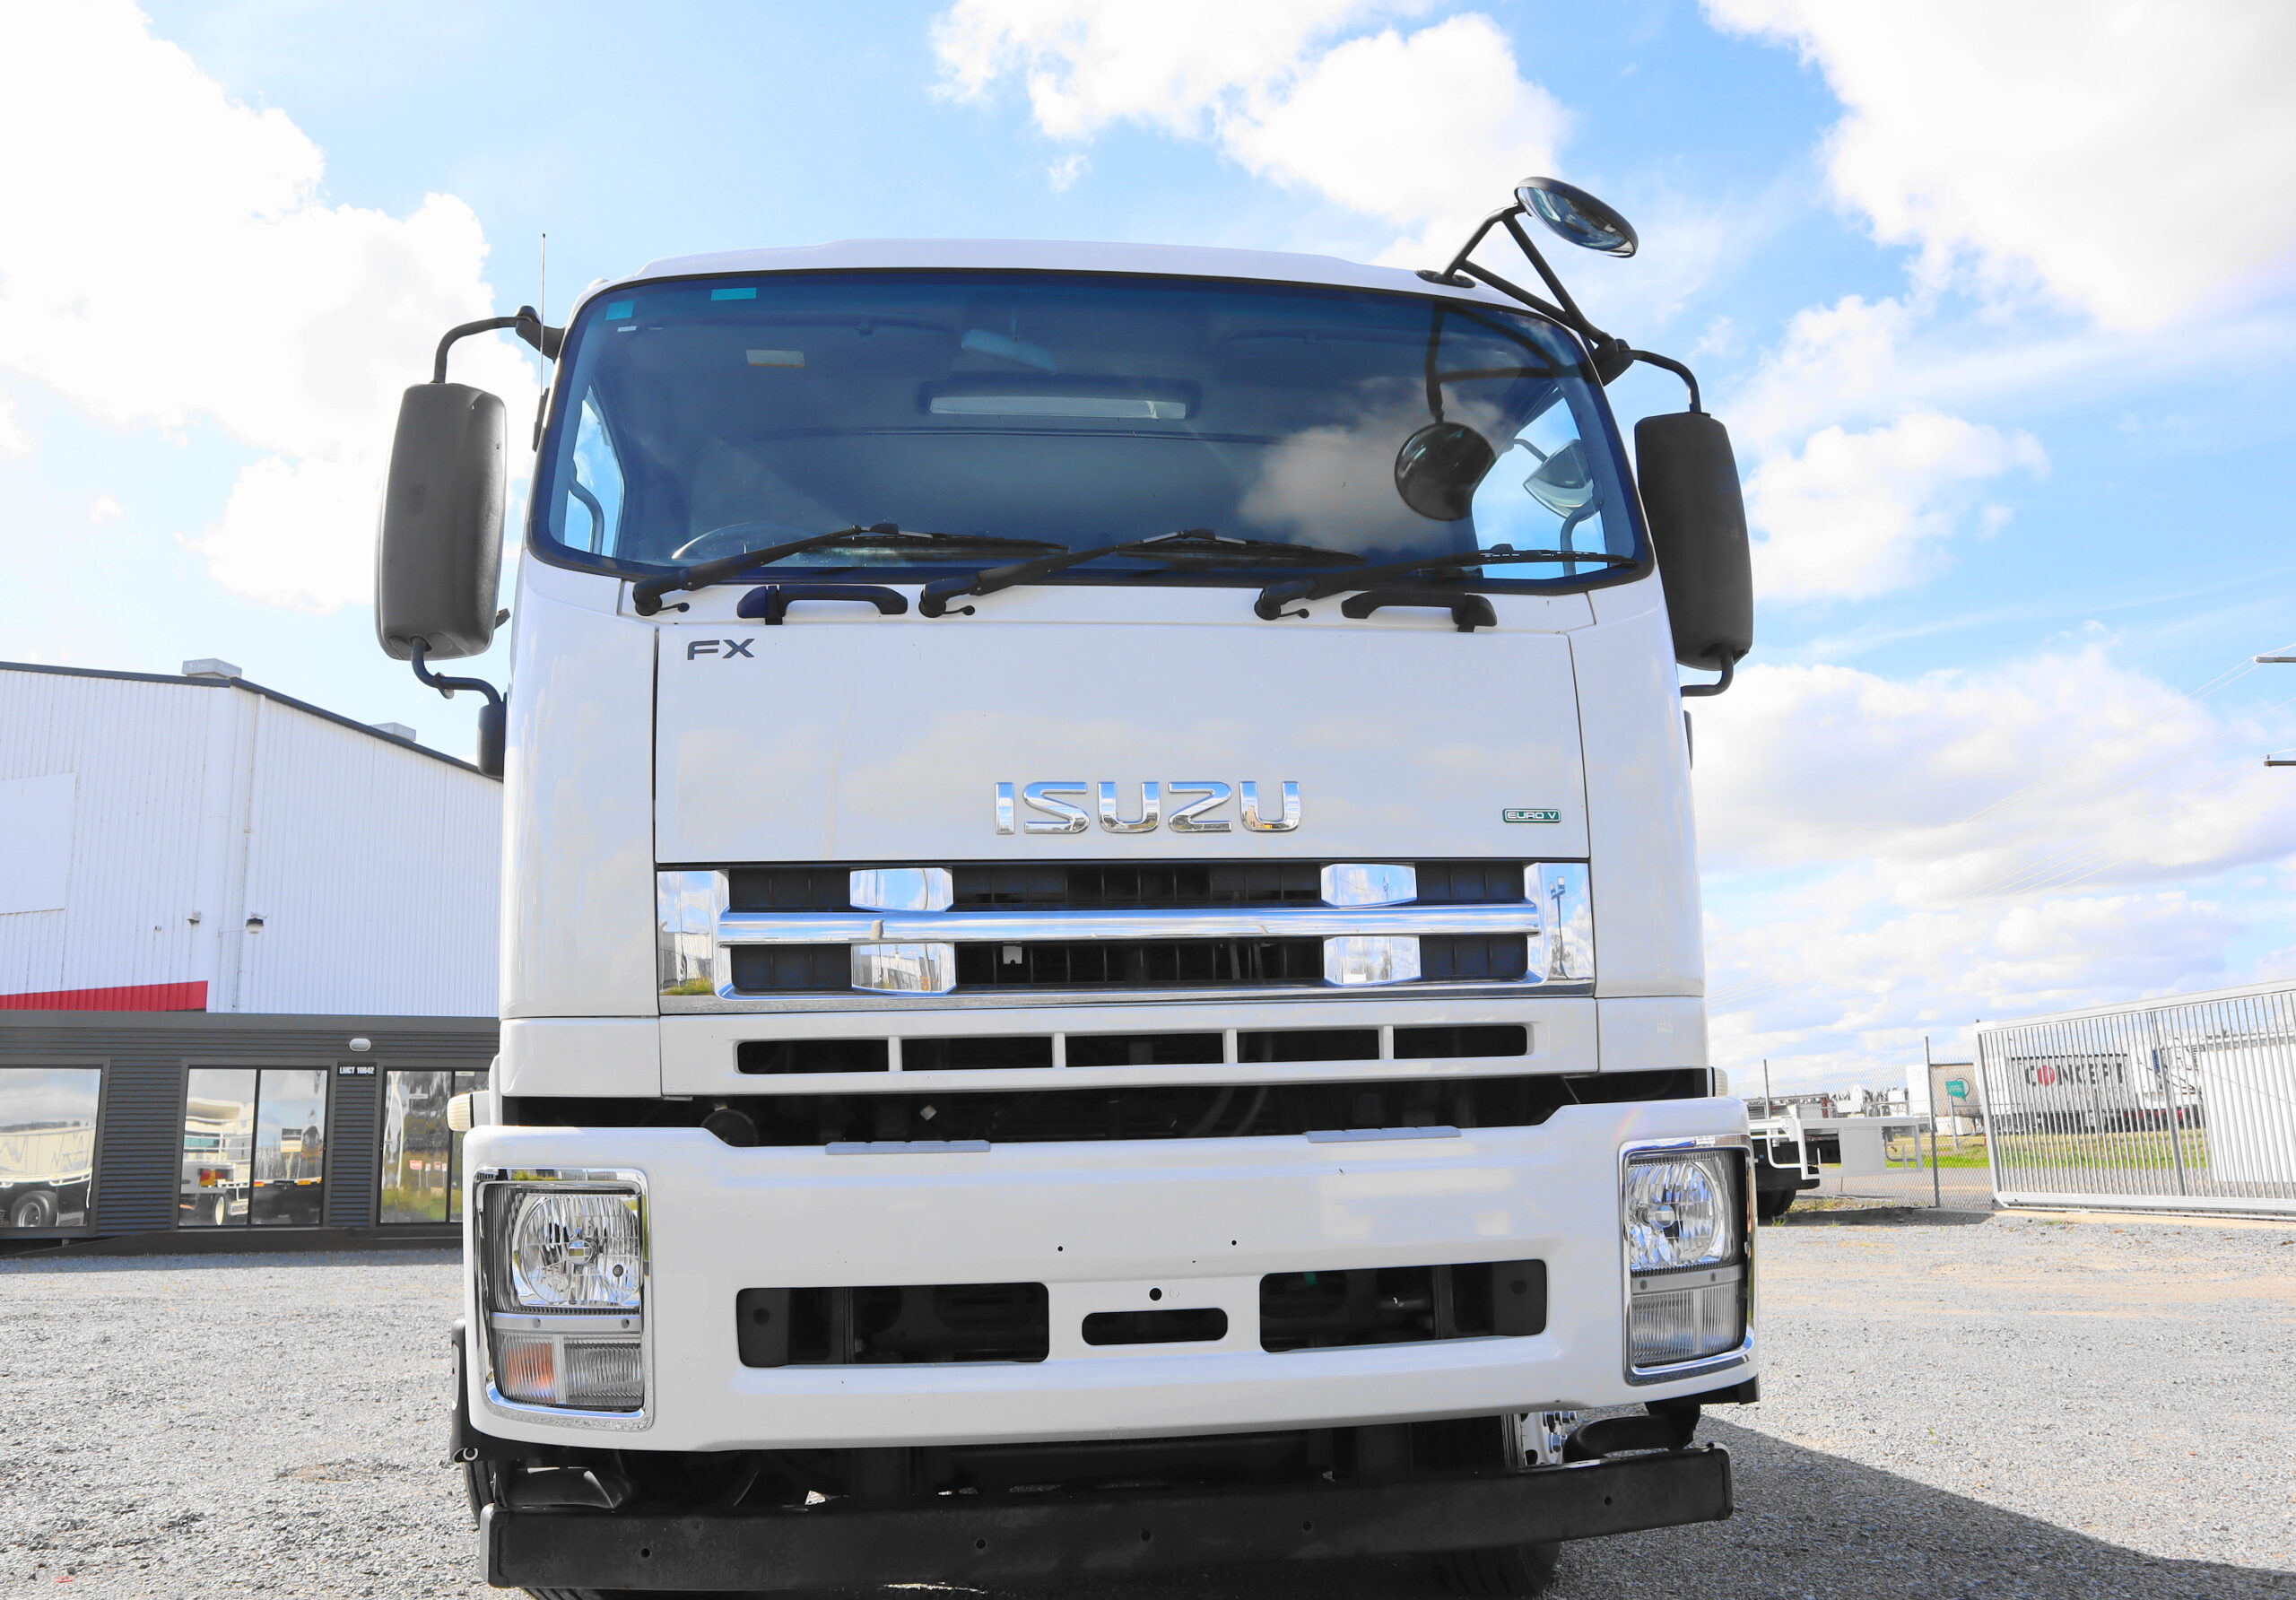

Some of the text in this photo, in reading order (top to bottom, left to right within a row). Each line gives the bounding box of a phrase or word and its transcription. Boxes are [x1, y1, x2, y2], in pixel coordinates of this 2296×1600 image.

[687, 639, 755, 660] FX
[995, 781, 1300, 835] ISUZU
[1507, 812, 1557, 820] EURO V
